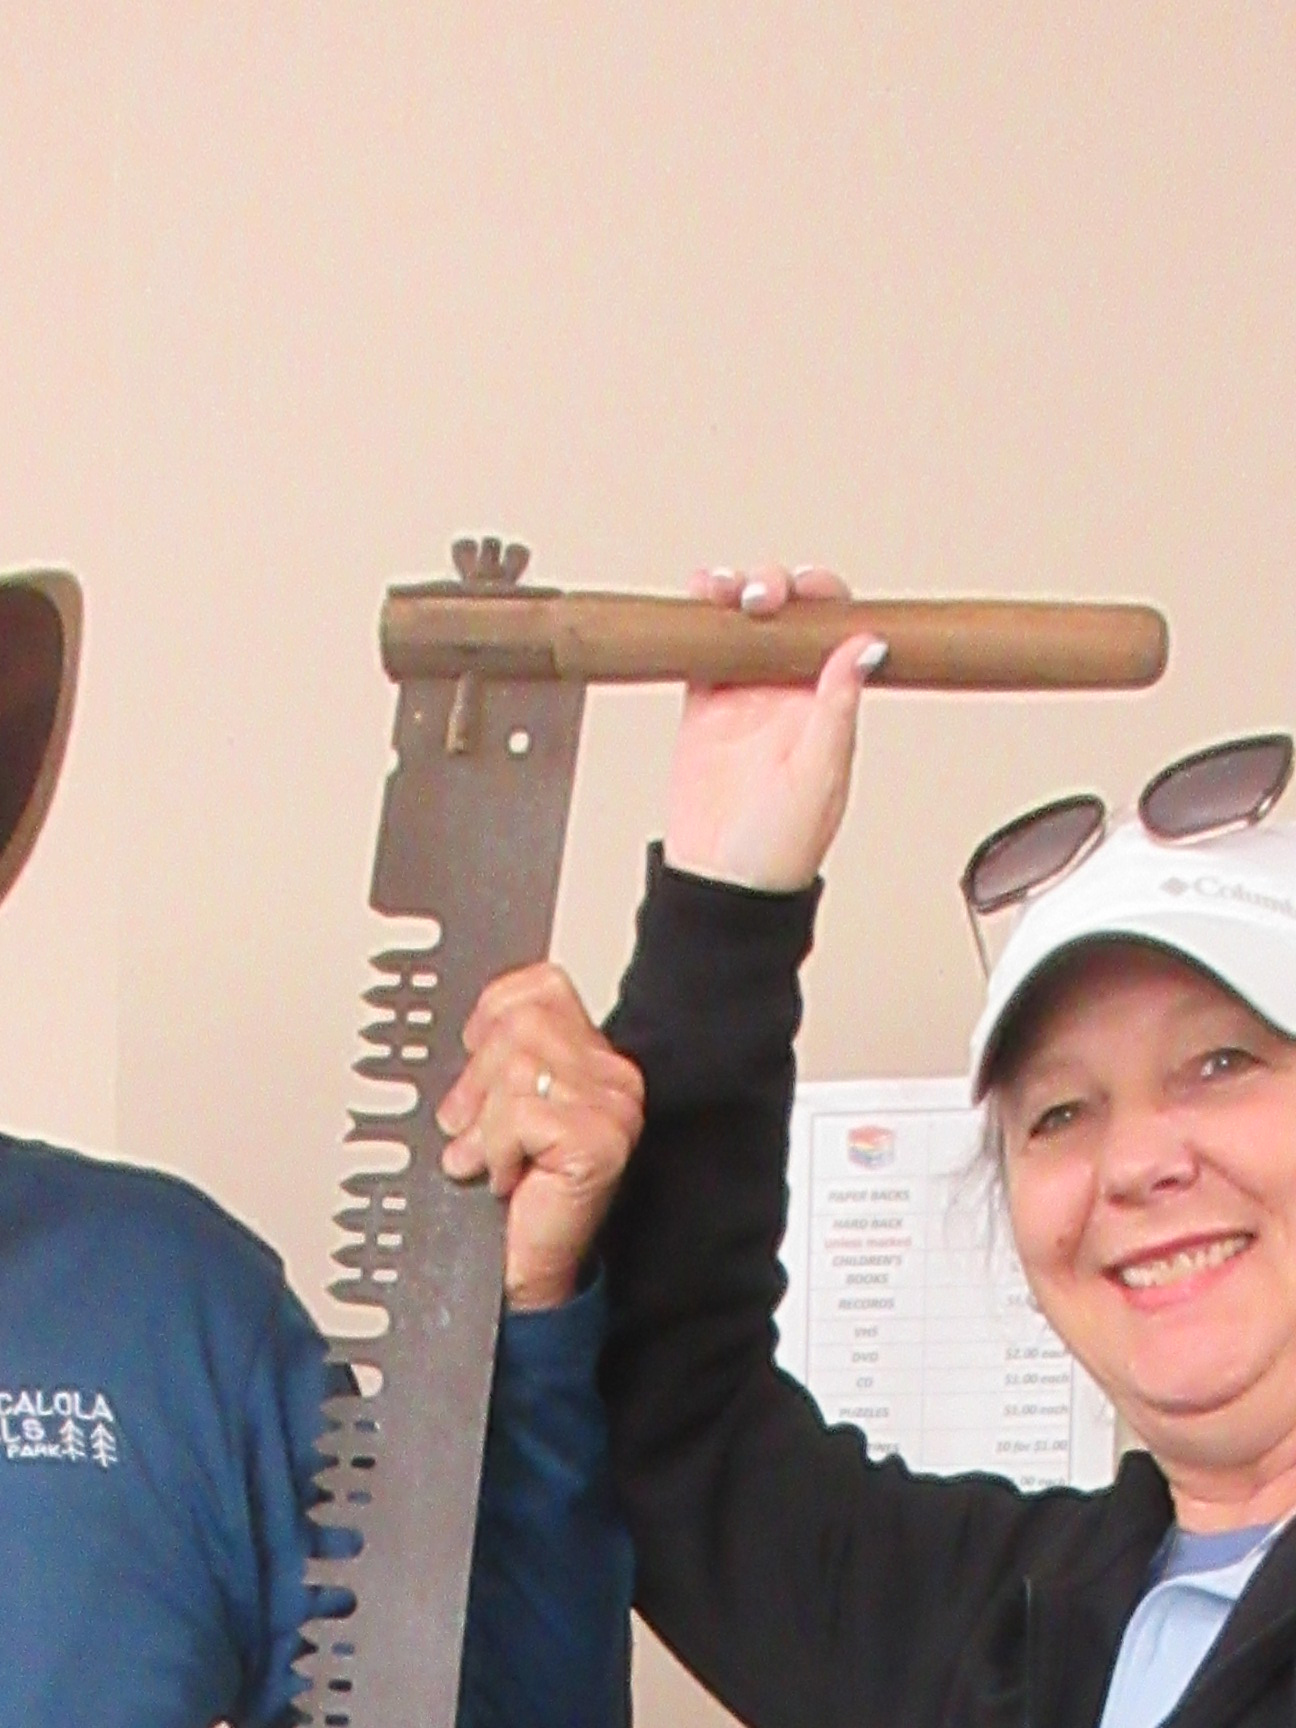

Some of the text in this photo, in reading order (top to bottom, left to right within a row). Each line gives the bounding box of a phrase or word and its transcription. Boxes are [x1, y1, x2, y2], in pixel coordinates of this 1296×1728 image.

[828, 1189, 910, 1202] PAPER BACKS
[833, 1217, 903, 1229] HARD BACK
[832, 1255, 902, 1267] CHILDREN'S
[846, 1273, 888, 1285] BOOKS
[838, 1298, 895, 1311] RECORDS
[852, 1352, 878, 1363] DVD
[856, 1377, 873, 1388] CD
[1040, 1373, 1069, 1384] each
[839, 1407, 889, 1418] PUZZLES
[1039, 1405, 1068, 1416] each
[6, 1443, 62, 1459] PARK
